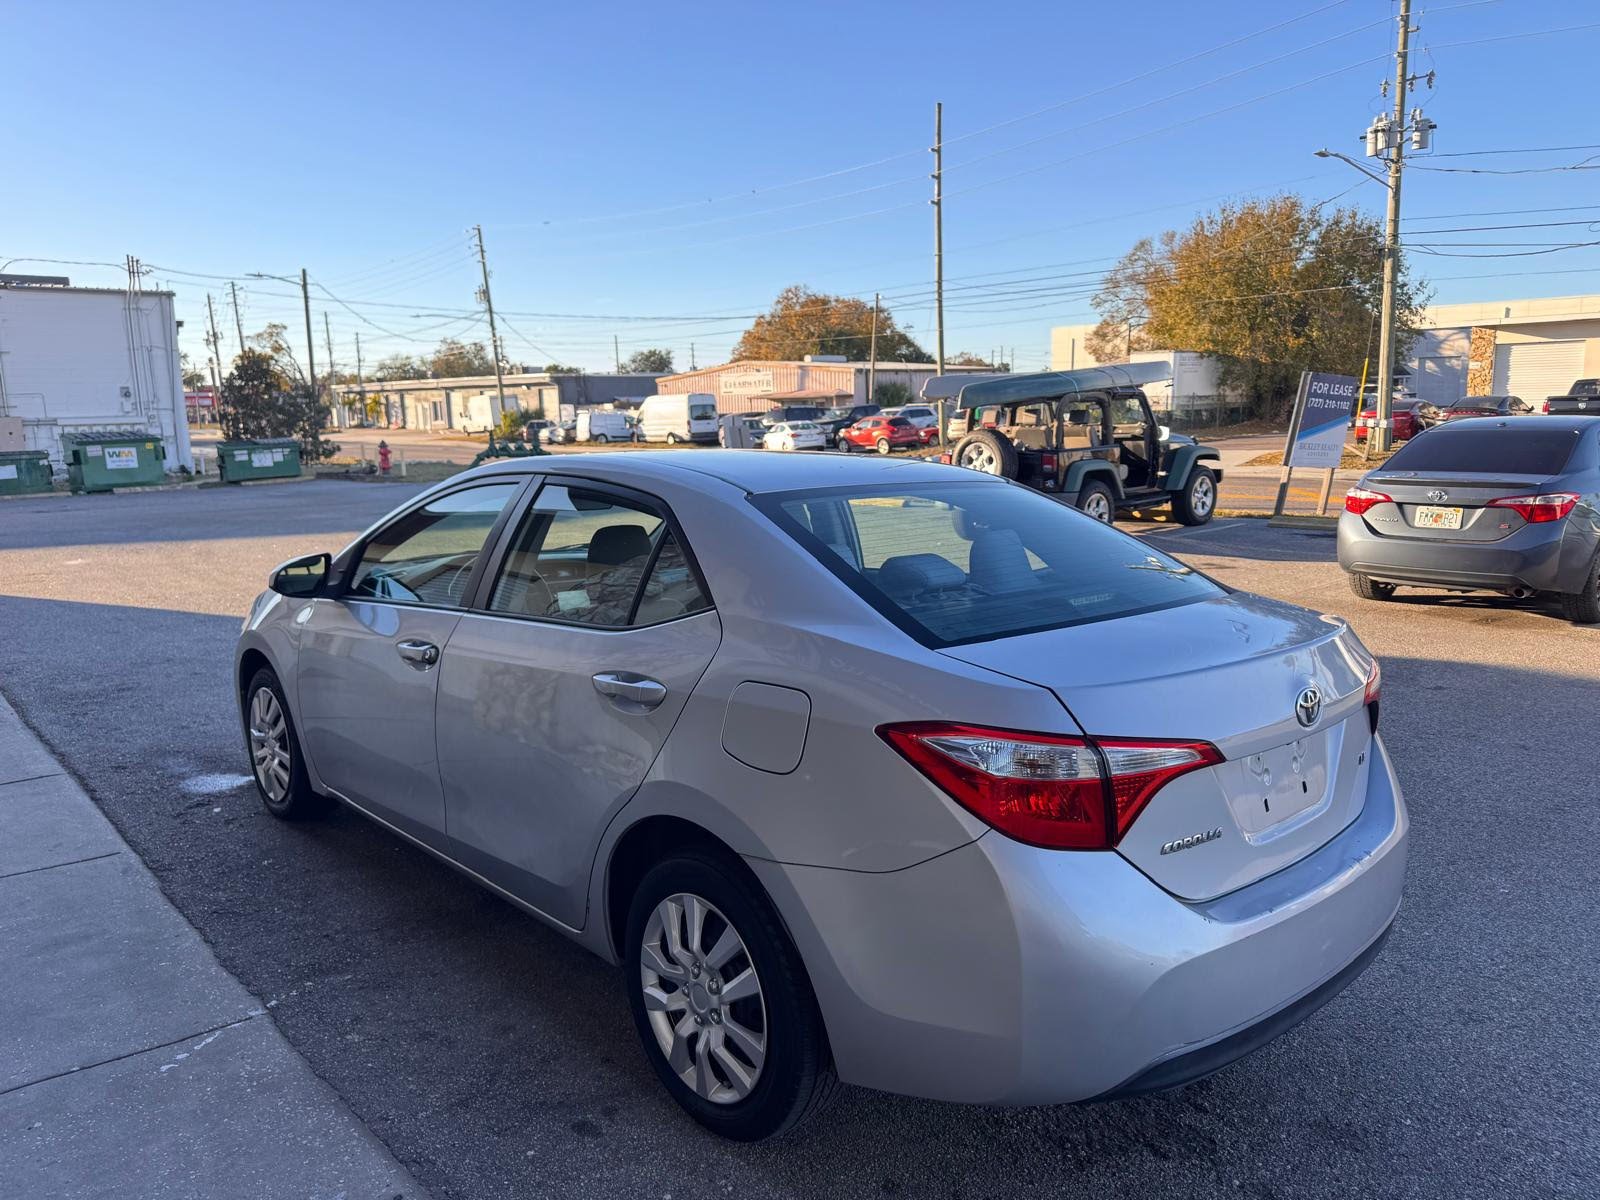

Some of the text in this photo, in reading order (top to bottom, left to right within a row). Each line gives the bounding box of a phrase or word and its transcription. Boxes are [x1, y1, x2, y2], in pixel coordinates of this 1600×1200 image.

[1311, 382, 1353, 396] FOR LEASE
[1308, 398, 1324, 408] (727)
[1160, 826, 1224, 855] COROLLA
